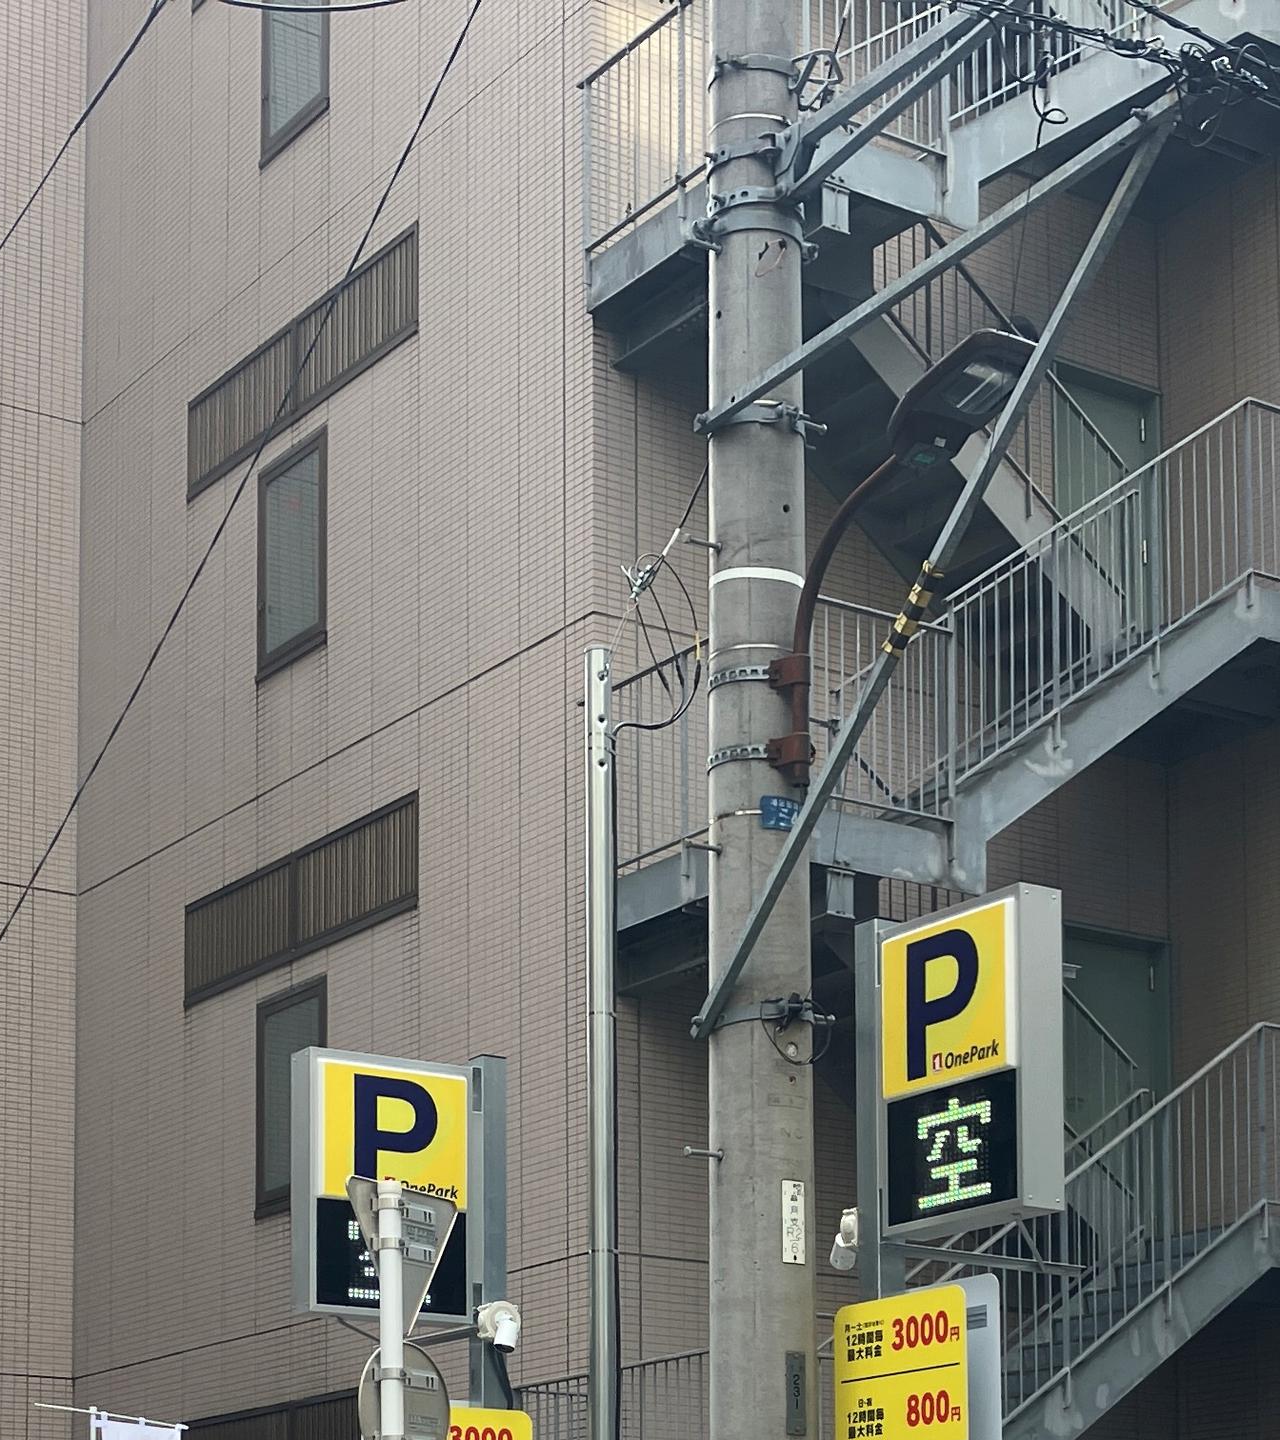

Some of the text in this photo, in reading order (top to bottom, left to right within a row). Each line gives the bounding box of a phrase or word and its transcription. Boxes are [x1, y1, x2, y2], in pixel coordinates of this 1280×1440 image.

[907, 929, 979, 1081] P
[945, 1039, 999, 1070] OnePark
[353, 1074, 438, 1178] P
[918, 1098, 991, 1209] 空
[892, 1311, 960, 1351] 3000円
[847, 1345, 882, 1362] 最大料金
[907, 1390, 961, 1427] 800円
[848, 1423, 883, 1440] 最大料金
